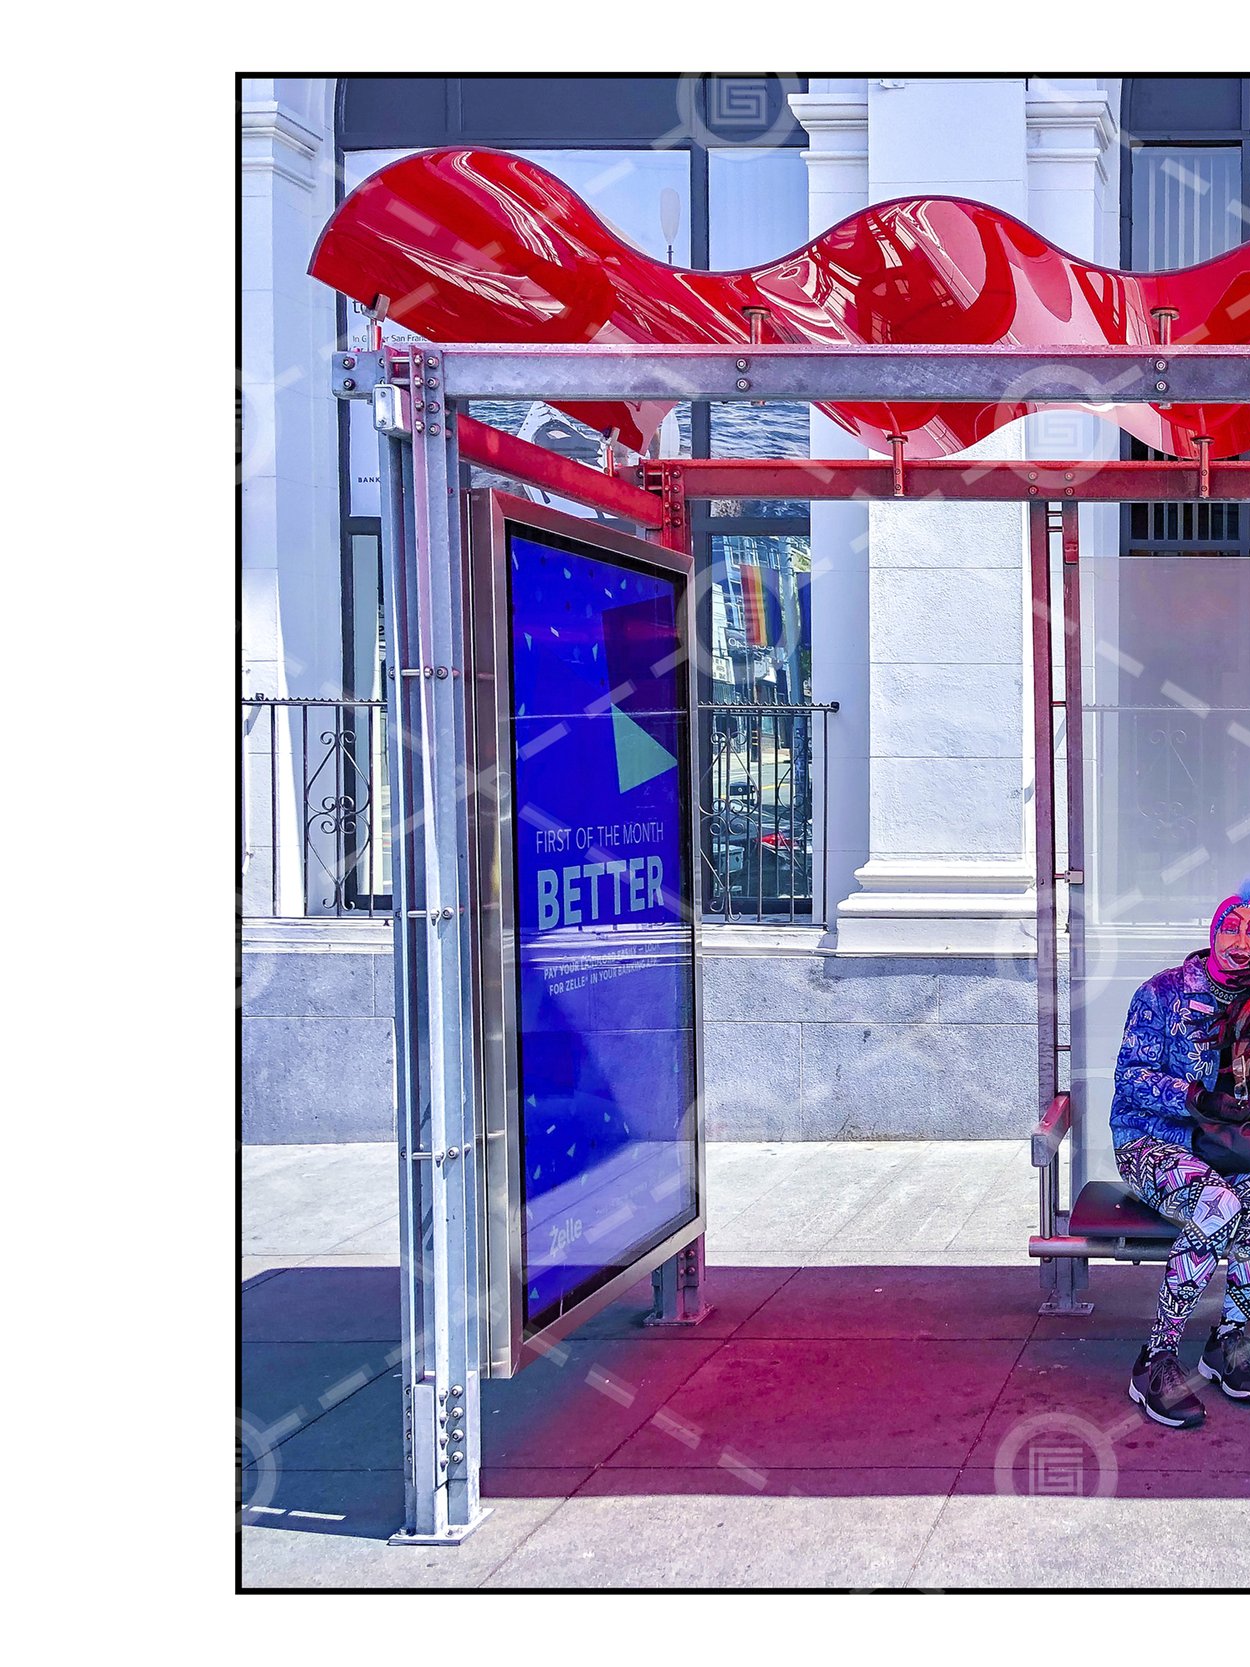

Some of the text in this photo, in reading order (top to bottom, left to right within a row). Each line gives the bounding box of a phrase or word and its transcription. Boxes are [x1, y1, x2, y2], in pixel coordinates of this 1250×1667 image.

[536, 822, 664, 853] FIRST OF THE MONTH
[537, 855, 664, 931] BETTER
[544, 967, 558, 980] PAY
[560, 960, 580, 976] YOUR
[549, 982, 564, 996] FOR
[590, 973, 598, 984] IN
[599, 969, 617, 981] YOUR
